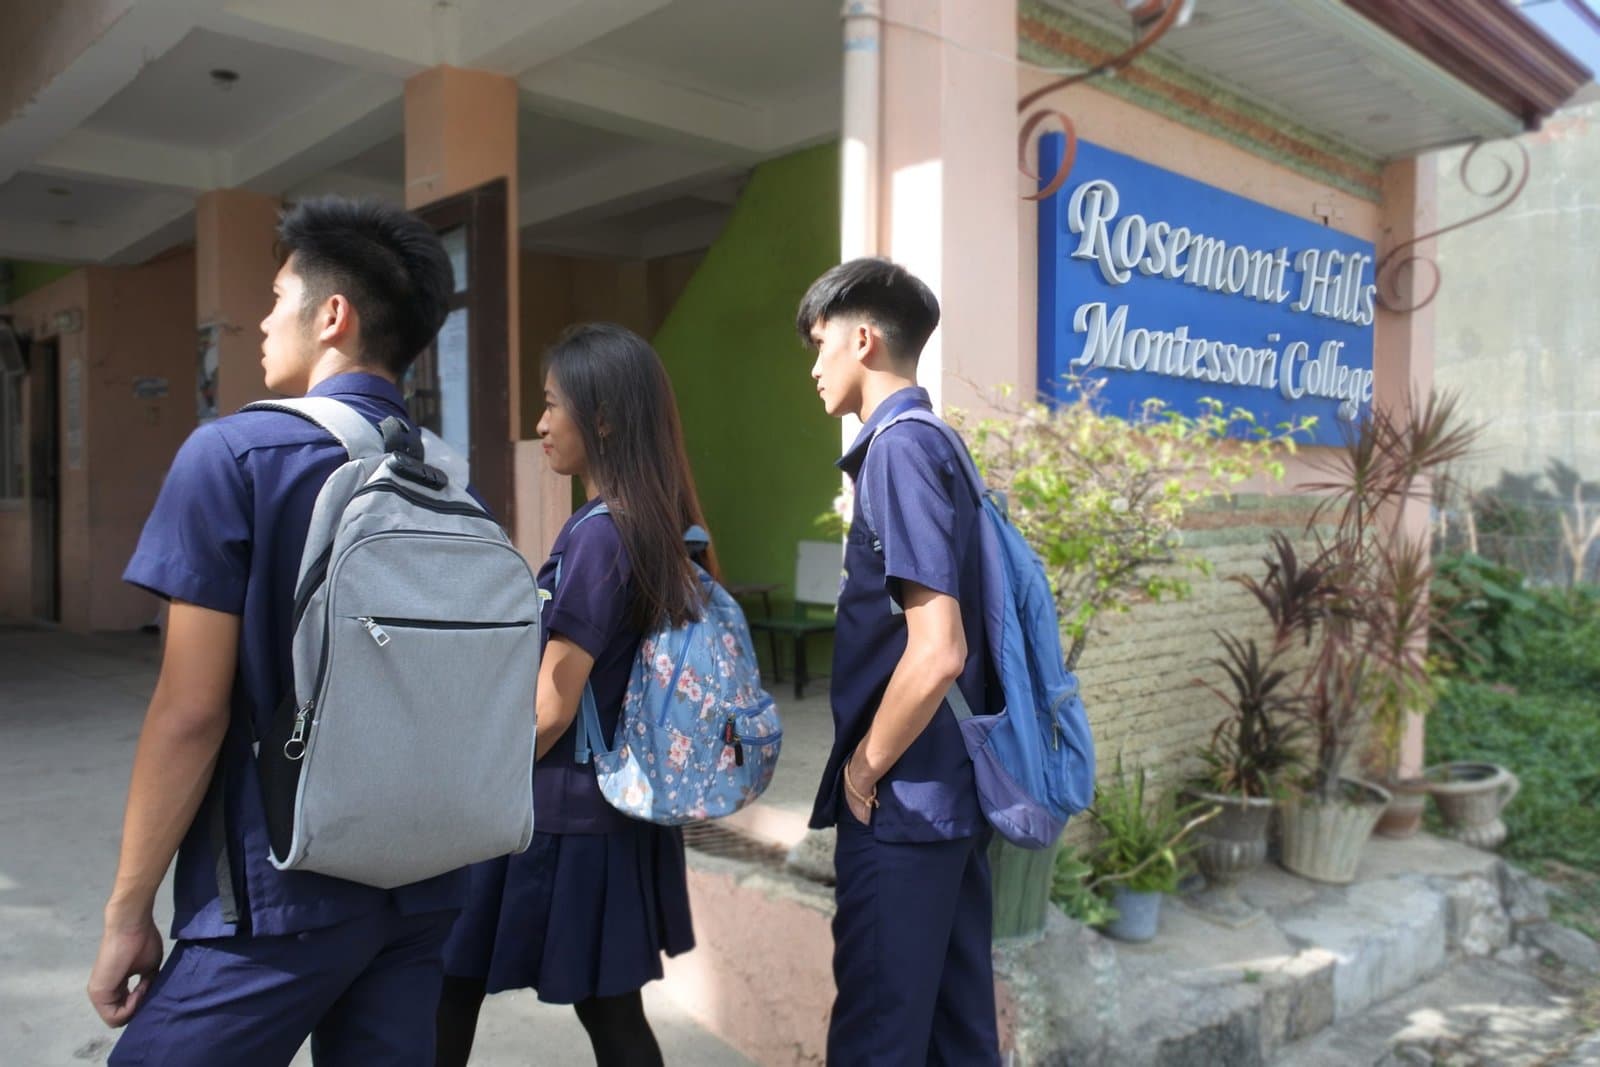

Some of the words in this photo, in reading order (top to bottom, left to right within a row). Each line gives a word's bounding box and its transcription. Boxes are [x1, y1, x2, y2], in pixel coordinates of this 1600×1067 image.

[1068, 179, 1290, 303] Rosemont
[1289, 248, 1377, 325] Hills
[1070, 302, 1280, 389] Montessori
[1281, 340, 1374, 421] College
